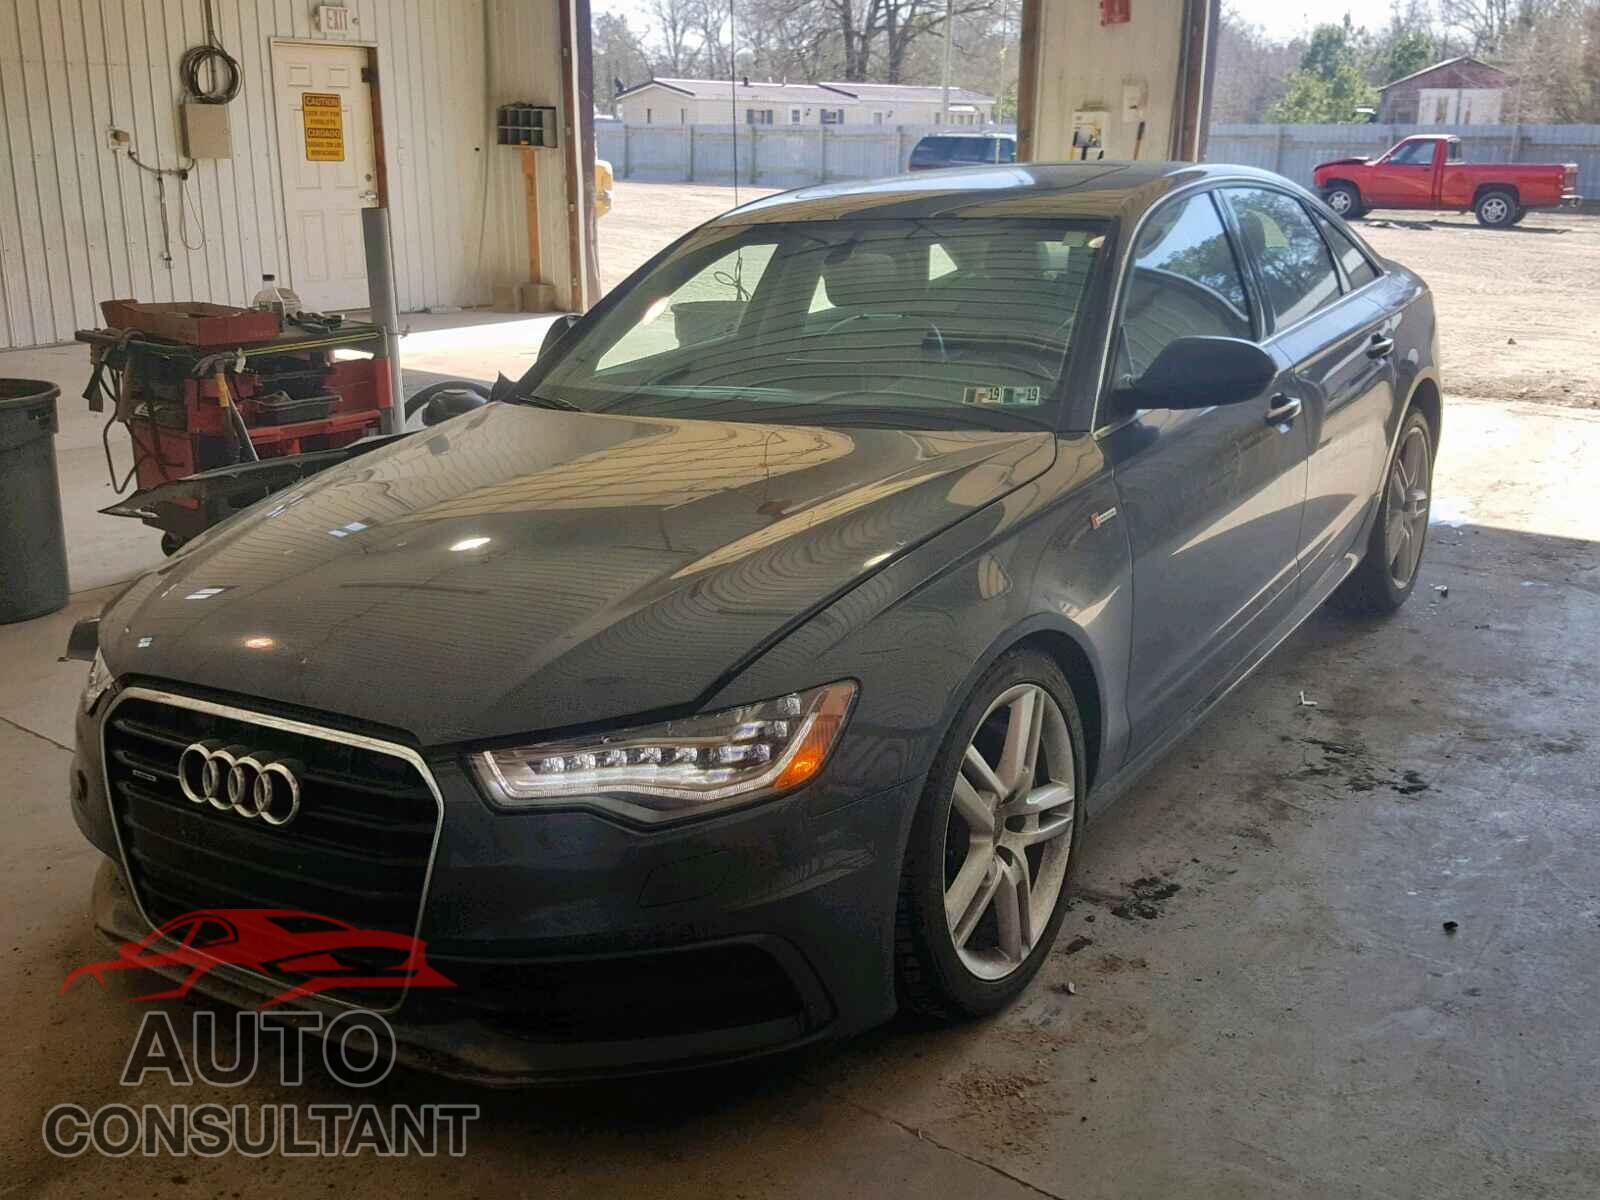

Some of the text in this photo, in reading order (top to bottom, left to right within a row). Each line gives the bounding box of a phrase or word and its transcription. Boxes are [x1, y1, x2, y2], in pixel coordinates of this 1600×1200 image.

[326, 8, 348, 31] EXIT
[305, 96, 339, 106] CAUTION
[988, 388, 1000, 401] 19
[1026, 388, 1038, 401] 19
